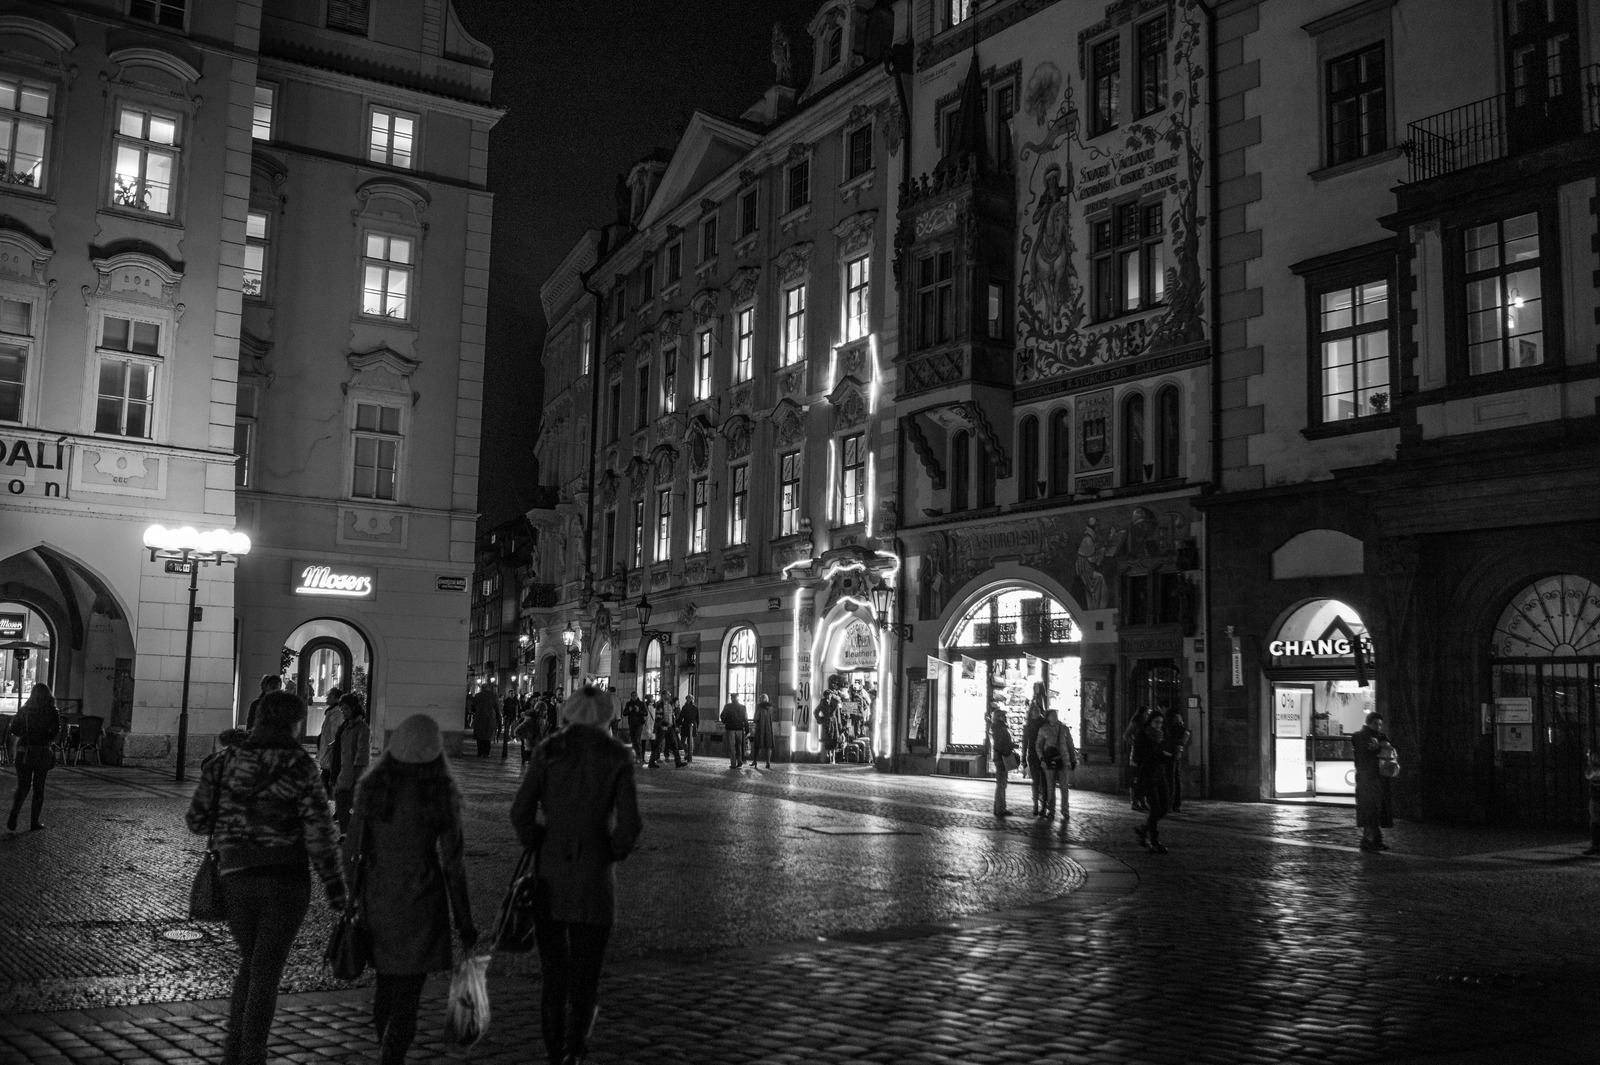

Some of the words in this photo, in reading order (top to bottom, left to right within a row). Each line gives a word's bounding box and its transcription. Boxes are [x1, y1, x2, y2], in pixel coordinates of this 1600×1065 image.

[296, 565, 372, 596] Moser
[797, 681, 810, 701] 30
[797, 704, 809, 725] 70
